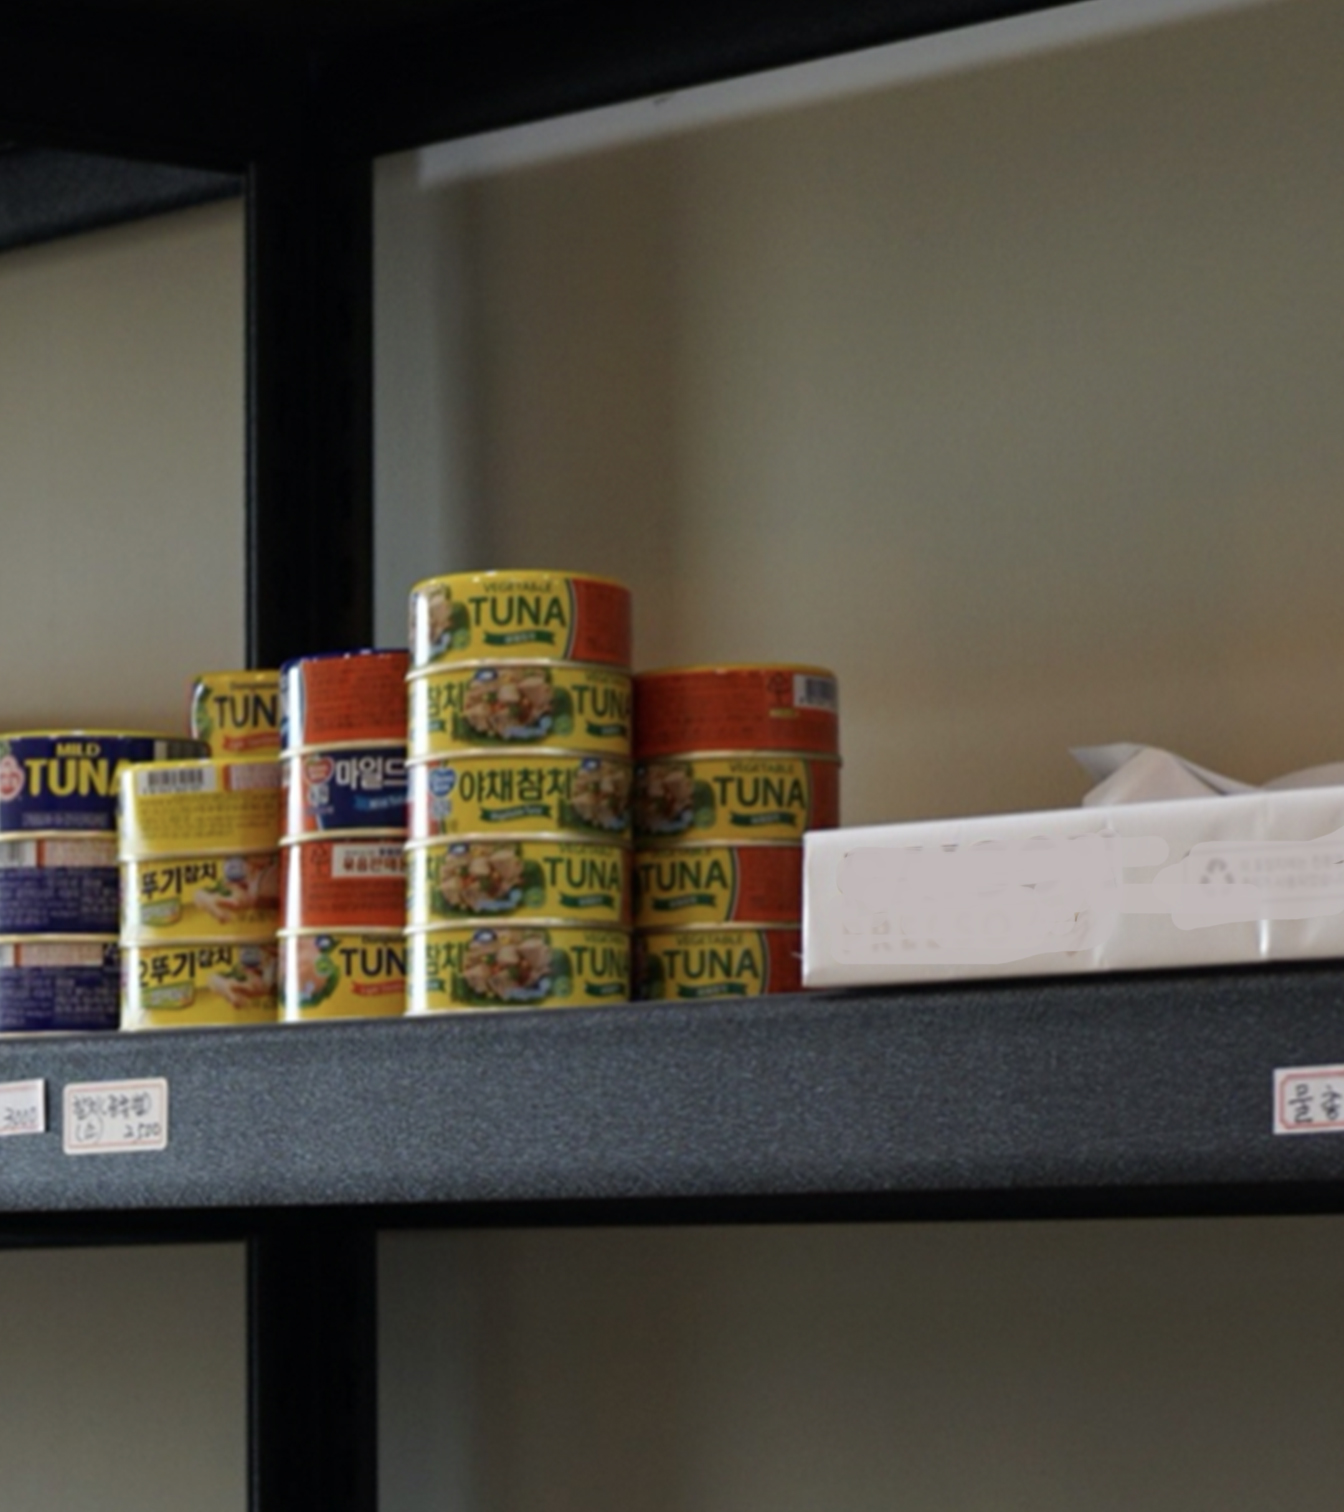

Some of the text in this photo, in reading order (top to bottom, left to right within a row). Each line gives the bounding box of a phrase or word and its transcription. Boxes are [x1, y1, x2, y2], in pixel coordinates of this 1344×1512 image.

[469, 595, 567, 626] TUNA
[55, 743, 100, 757] MILD
[713, 776, 806, 808] TUNA
[641, 859, 728, 891] TUNA
[662, 949, 759, 980] TUNA
